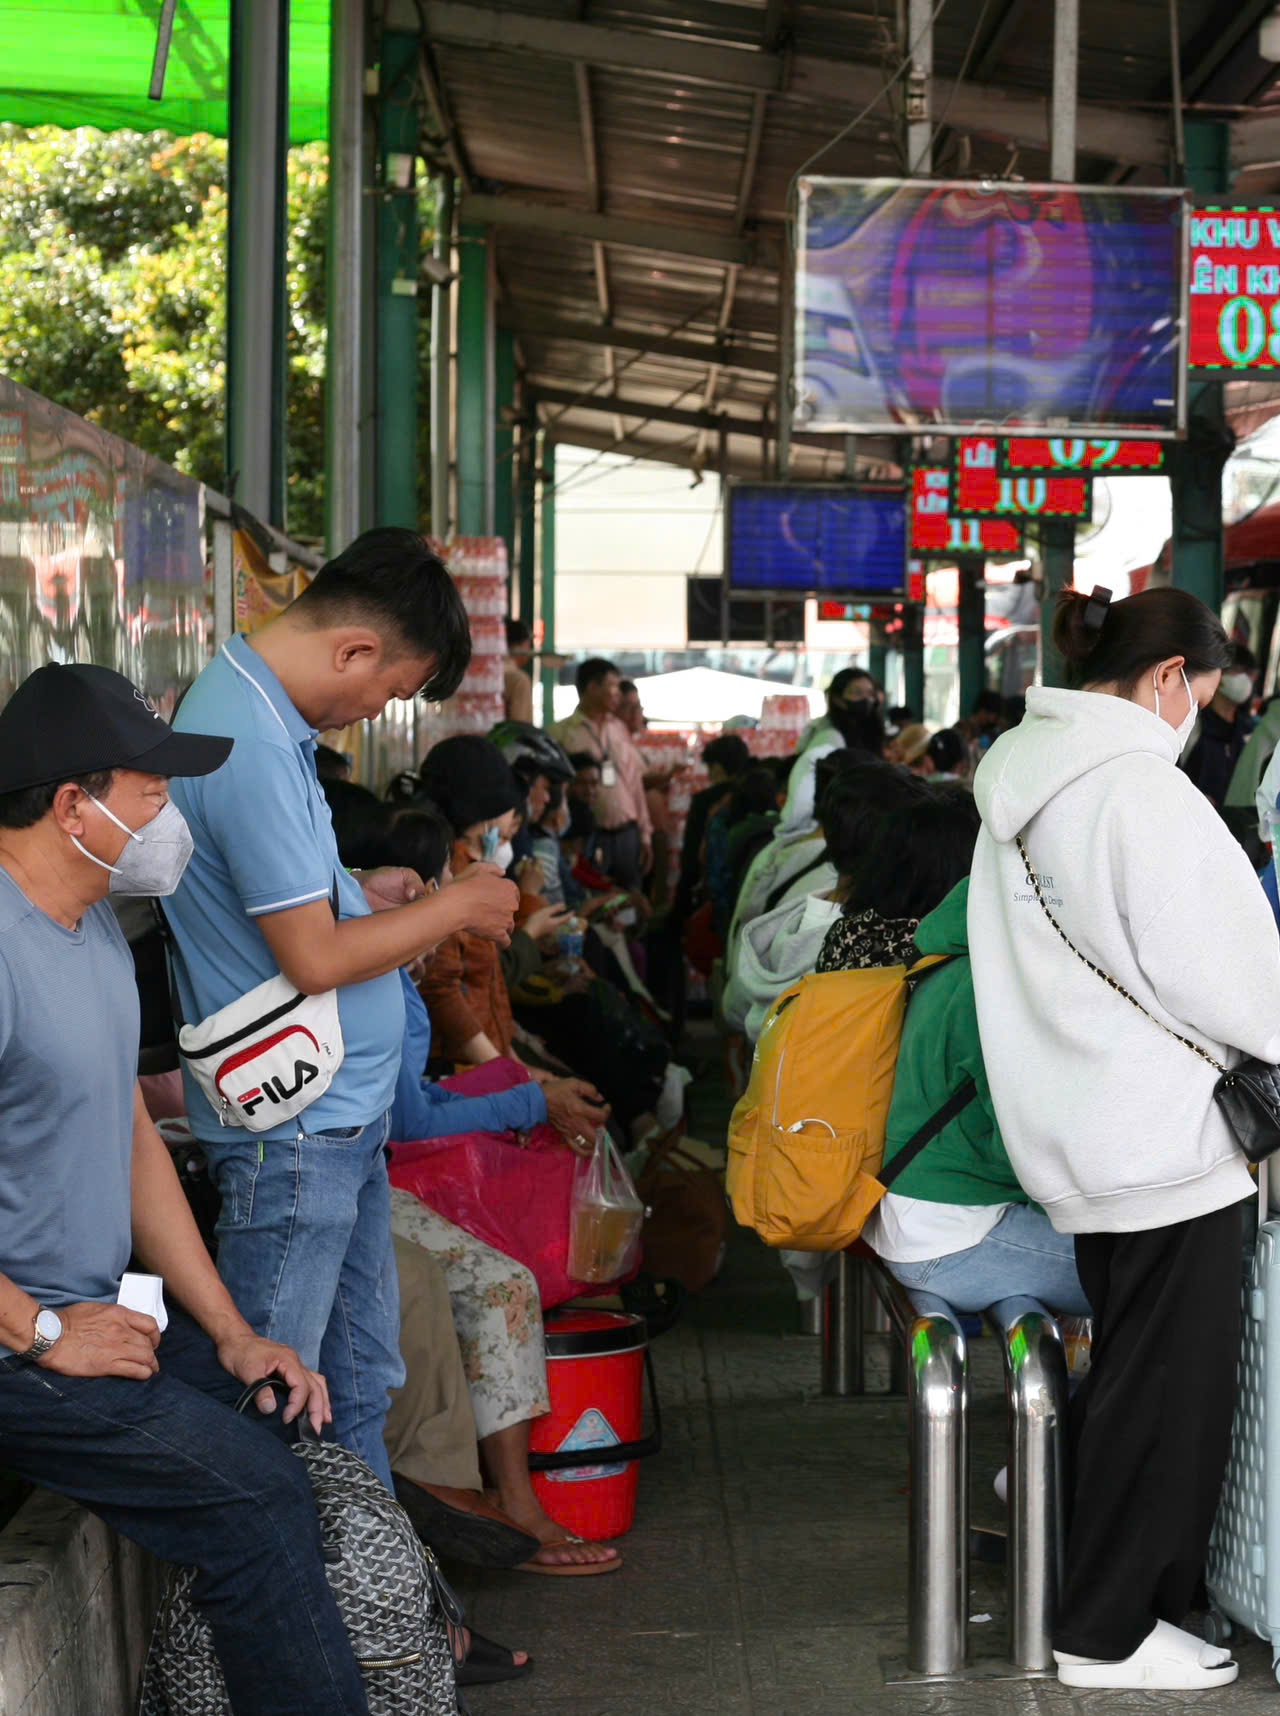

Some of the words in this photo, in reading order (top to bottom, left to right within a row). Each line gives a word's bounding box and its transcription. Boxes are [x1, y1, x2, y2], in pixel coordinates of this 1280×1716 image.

[1190, 217, 1260, 249] KHU
[1190, 254, 1239, 295] ÊN
[995, 477, 1047, 511] 10
[947, 518, 983, 549] 11
[237, 1059, 319, 1117] FILA
